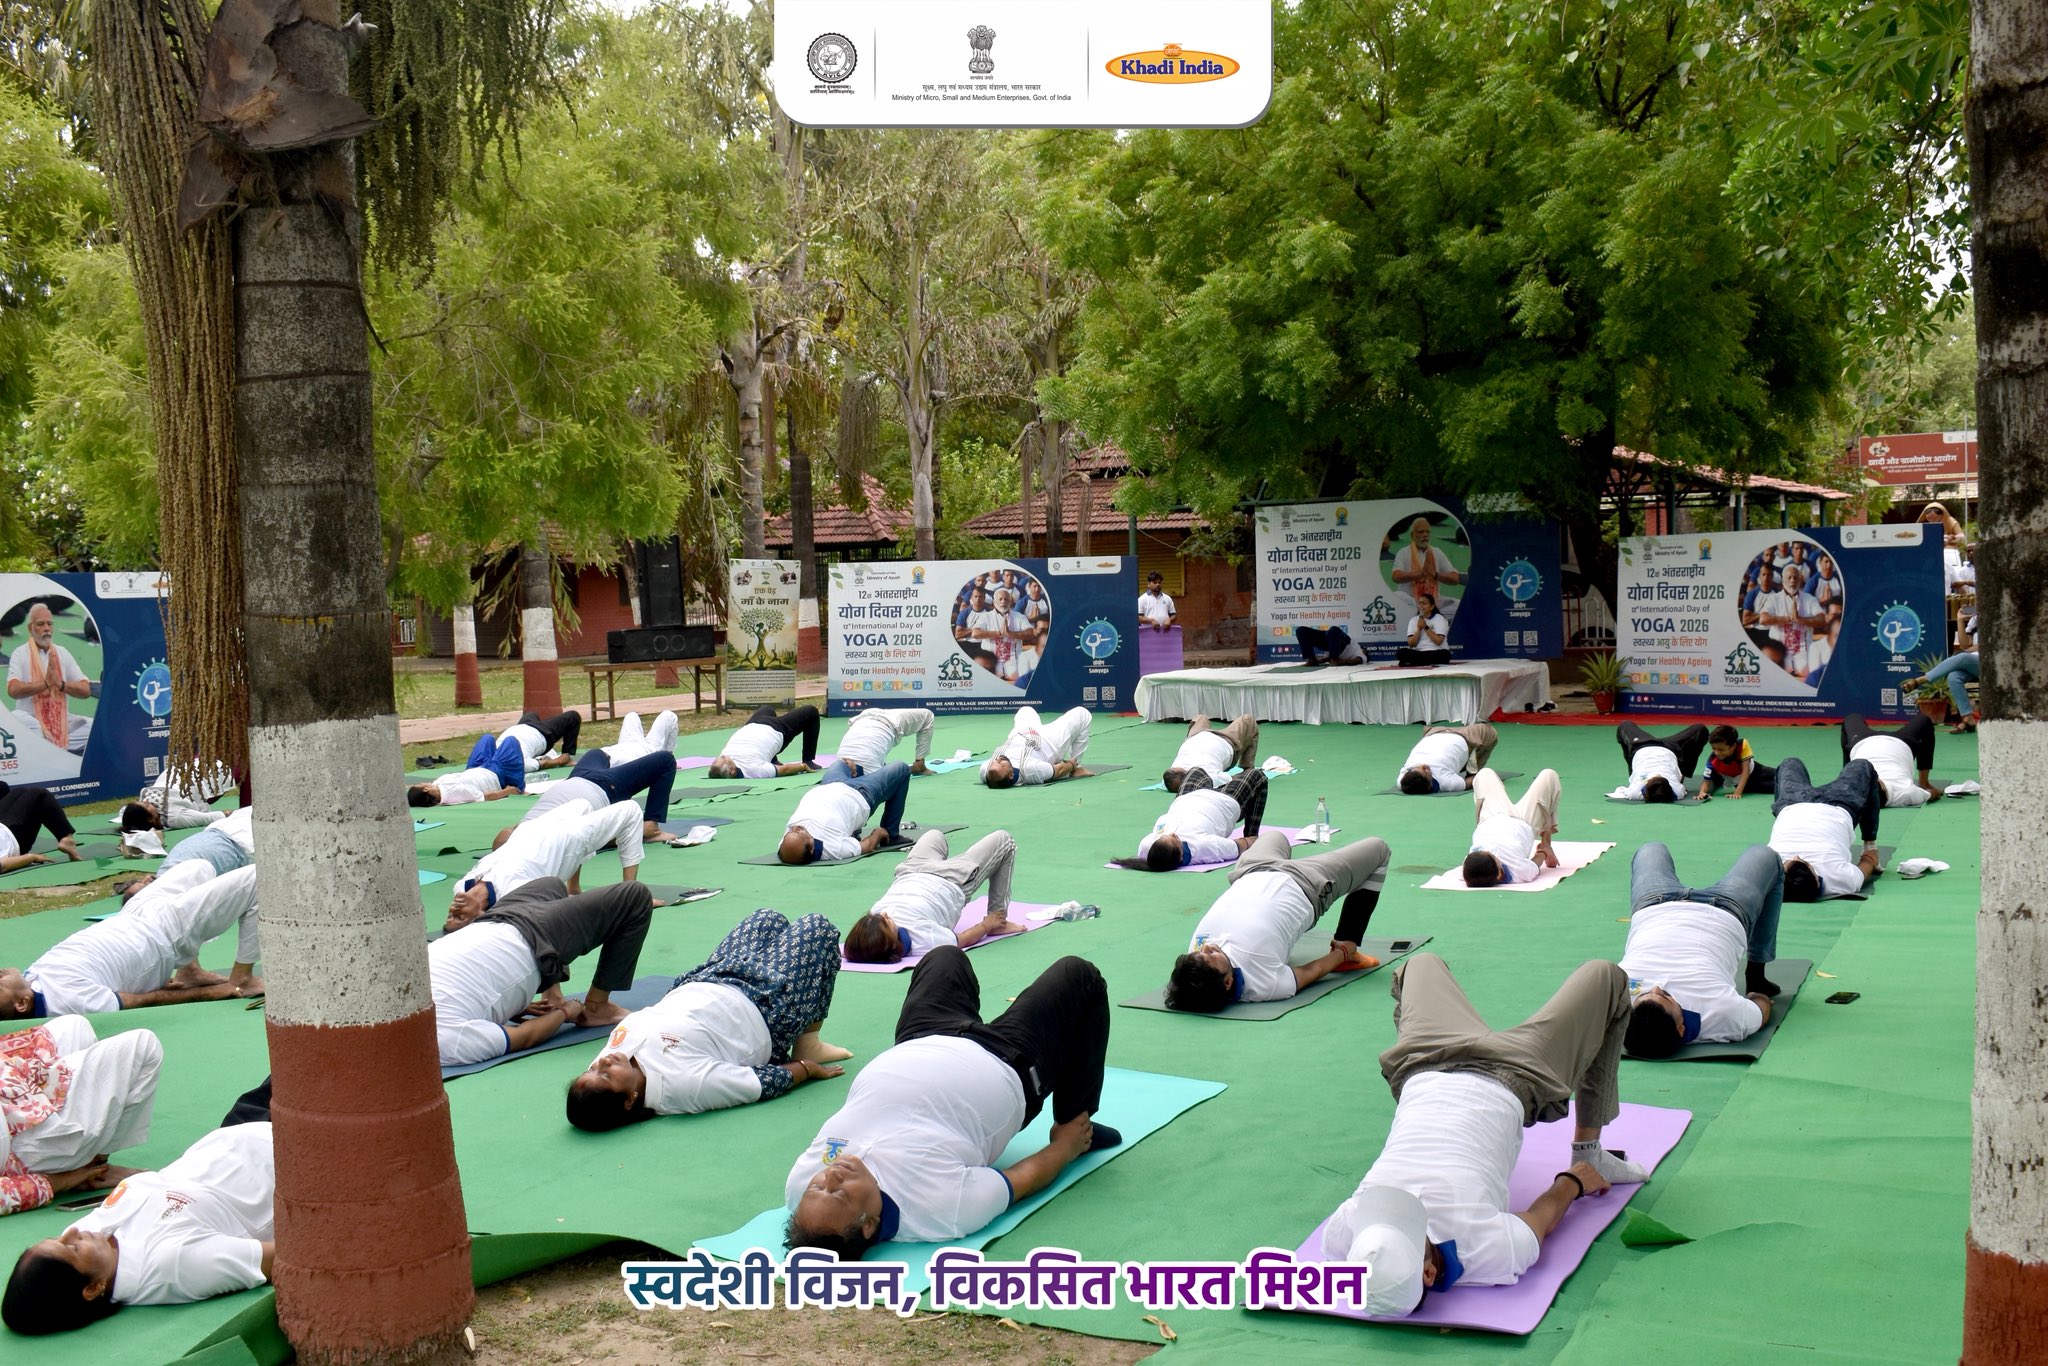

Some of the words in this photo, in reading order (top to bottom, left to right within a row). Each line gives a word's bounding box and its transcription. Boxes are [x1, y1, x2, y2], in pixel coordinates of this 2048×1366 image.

[1934, 454, 1957, 462] आयोग
[1301, 529, 1342, 542] अंतरराष्ट्रीय
[1267, 547, 1293, 563] योग
[1296, 546, 1327, 562] दिवस
[1331, 547, 1361, 560] 2026
[1280, 565, 1323, 574] International
[1663, 564, 1705, 578] अंतरराष्ट्रीय
[1272, 578, 1314, 591] YOGA
[1320, 577, 1346, 589] 2026
[875, 587, 918, 600] अंतरराष्ट्रीय
[1627, 583, 1654, 600] योग
[1657, 582, 1689, 600] दिवस
[1693, 585, 1724, 600] 2026
[756, 597, 765, 605] के
[1297, 595, 1310, 604] आयु
[1311, 593, 1317, 602] के
[1319, 593, 1332, 601] लिए
[1334, 593, 1346, 601] योग
[838, 603, 866, 619] योग
[869, 603, 903, 618] दिवस
[906, 605, 938, 617] 2026
[1686, 605, 1700, 614] Day
[1271, 612, 1287, 621] Yoga
[1300, 611, 1325, 620] Healthy
[1327, 610, 1350, 619] Ageing
[1632, 618, 1675, 632] YOGA
[1680, 619, 1709, 632] 2026
[843, 634, 888, 646] YOGA
[893, 634, 922, 646] 2026
[1656, 638, 1670, 649] आयु
[1672, 636, 1678, 646] के
[1679, 636, 1693, 646] लिए
[1695, 636, 1707, 646] योग
[870, 651, 883, 660] आयु
[884, 649, 891, 658] के
[892, 649, 906, 658] लिए
[908, 649, 921, 658] योग
[1629, 657, 1646, 666] Yoga
[1659, 657, 1685, 667] Healthy
[1687, 657, 1712, 667] Ageing
[841, 667, 859, 676] Yoga
[872, 667, 899, 676] Healthy
[901, 667, 926, 675] Ageing
[1724, 676, 1744, 684] Yoga
[1, 760, 18, 770] 365
[1703, 767, 1712, 778] 2
[62, 781, 100, 791] COMMISSION
